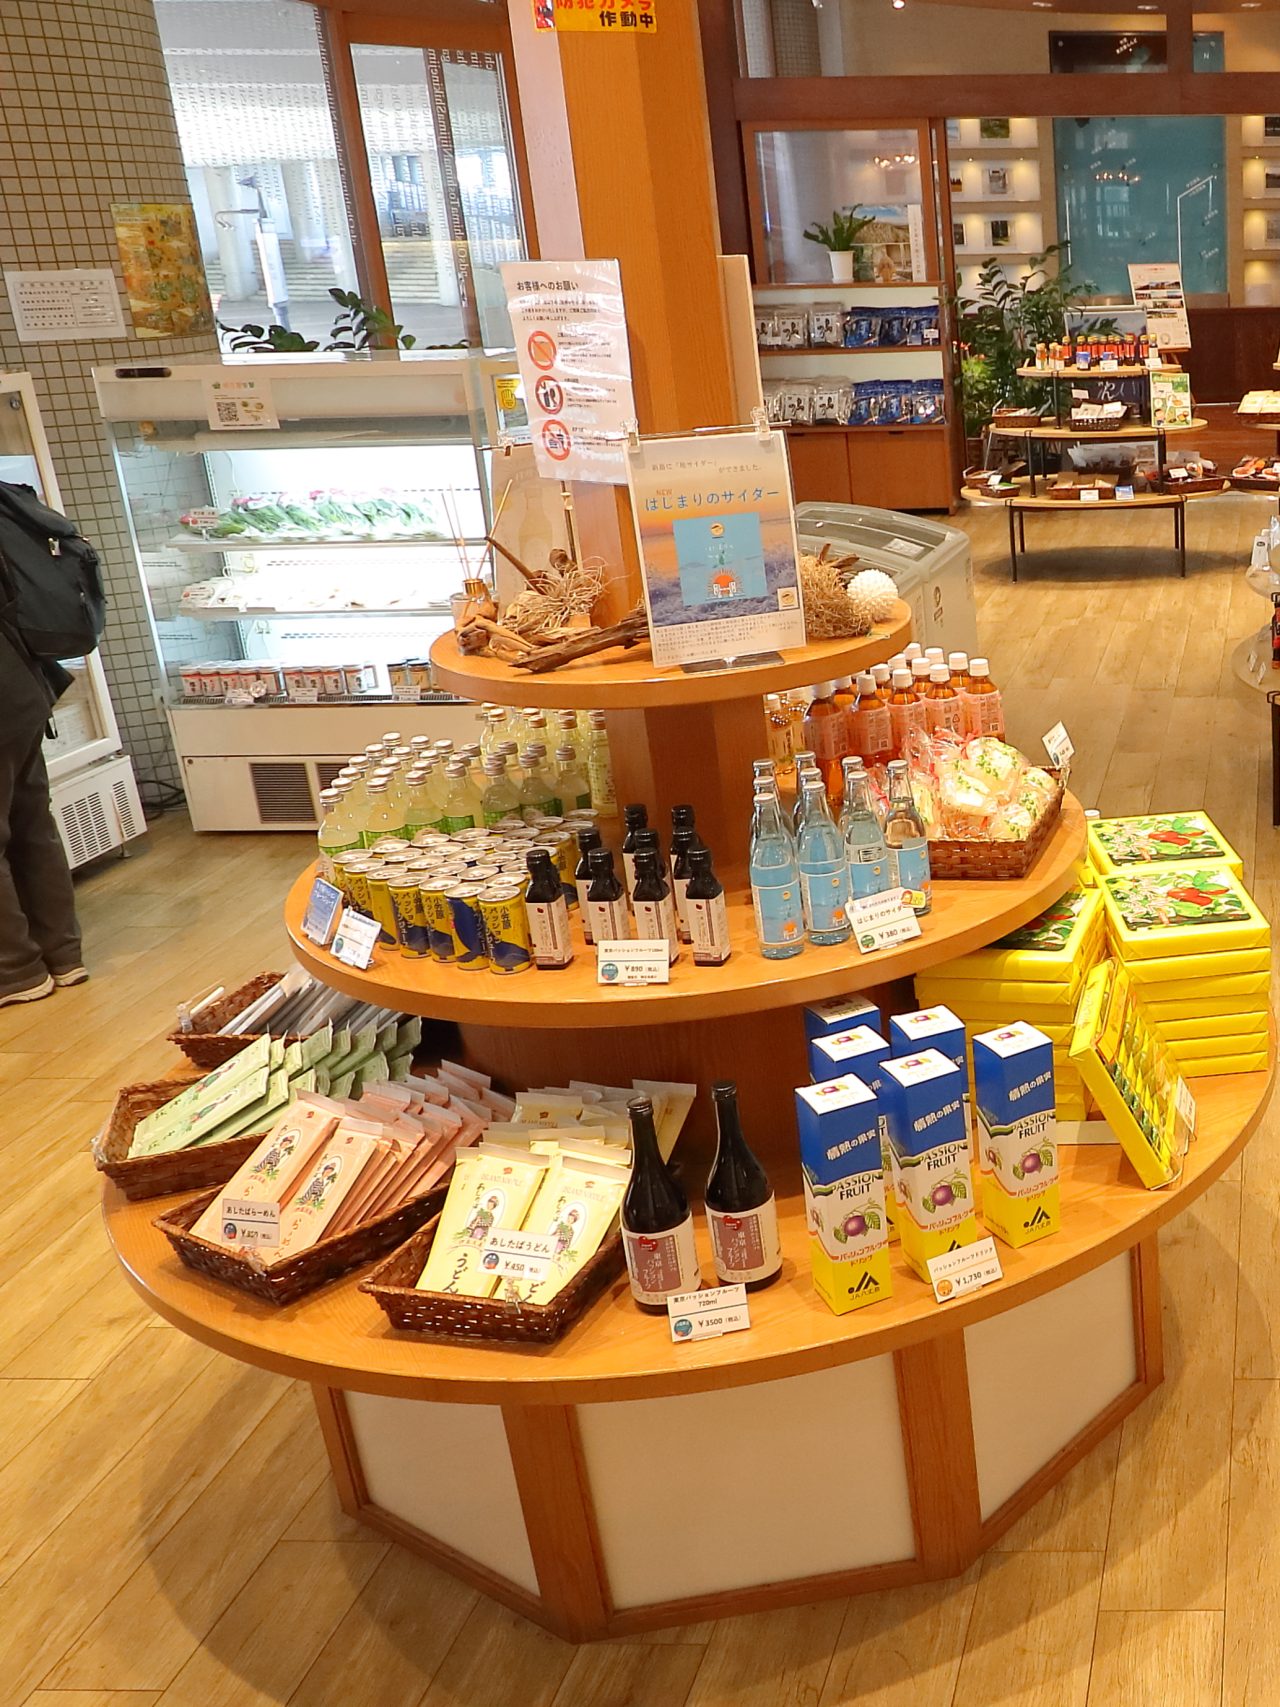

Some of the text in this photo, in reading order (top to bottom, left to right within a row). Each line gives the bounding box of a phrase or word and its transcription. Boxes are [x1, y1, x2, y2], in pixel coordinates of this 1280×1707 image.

[599, 10, 654, 28] 作動中
[516, 280, 579, 291] お客様へのお願い
[500, 906, 512, 930] 小笠原
[857, 904, 902, 925] はじまりのサイダ
[489, 906, 502, 945] パッション
[1013, 1110, 1056, 1131] PASSION
[1018, 1121, 1046, 1140] FRUIT
[920, 1141, 969, 1163] PASSION
[926, 1153, 958, 1171] FRUIT
[832, 1172, 884, 1193] PASSION
[840, 1182, 871, 1200] FRUIT
[226, 1205, 276, 1218] あしたばらーめん
[489, 1236, 551, 1254] あしたばうどん
[442, 1252, 469, 1295] うどん
[504, 1260, 525, 1273] ¥450
[955, 1271, 982, 1287] ¥1,730
[673, 1286, 741, 1304] 東京パッションフルーツ
[698, 1298, 719, 1309] 720ml
[698, 1318, 724, 1334] ¥3500
